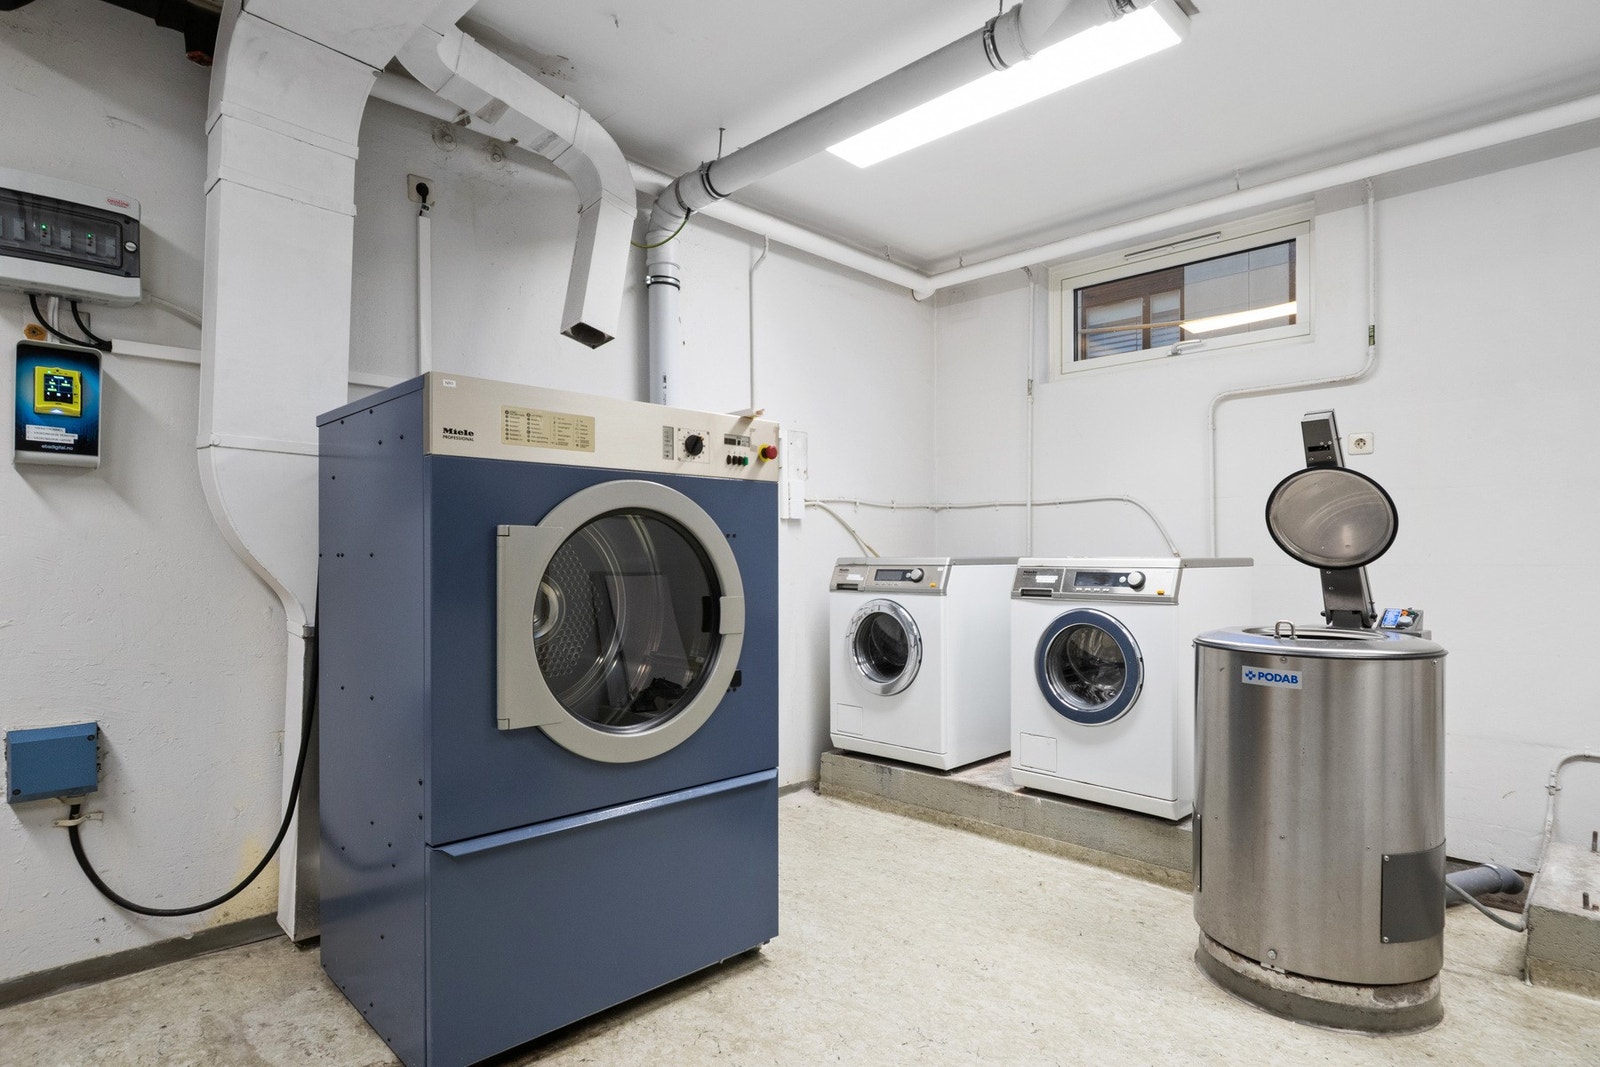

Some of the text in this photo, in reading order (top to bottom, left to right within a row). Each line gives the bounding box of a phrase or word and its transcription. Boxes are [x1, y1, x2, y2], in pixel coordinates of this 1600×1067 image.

[443, 427, 474, 437] Miele
[442, 434, 474, 442] PROFESSIONAL
[1257, 671, 1299, 684] PODAB
